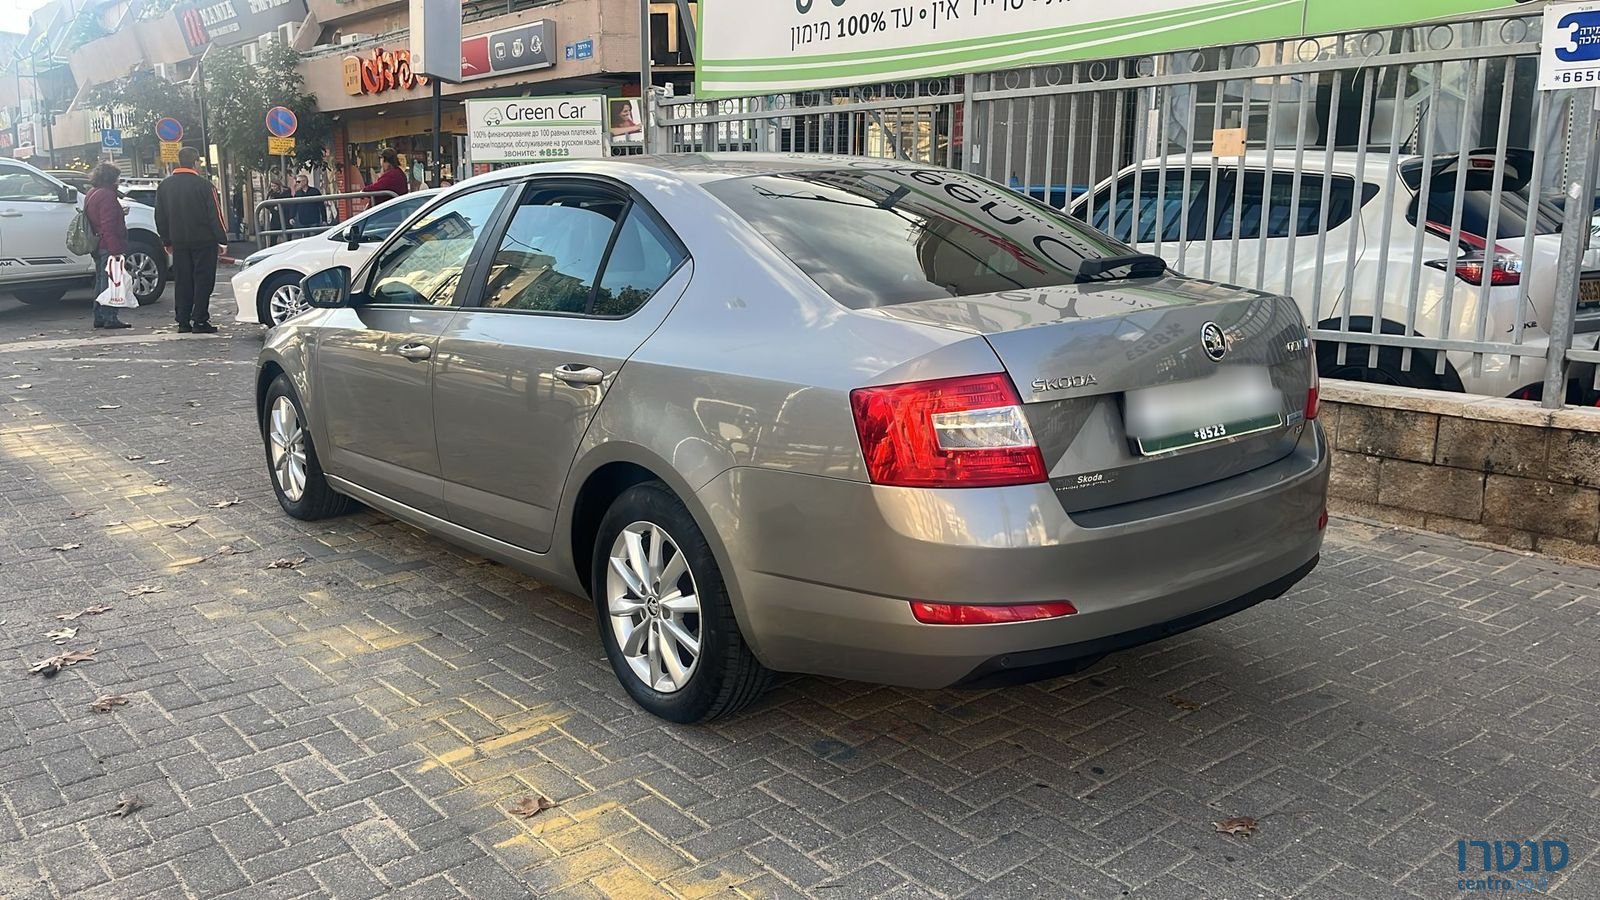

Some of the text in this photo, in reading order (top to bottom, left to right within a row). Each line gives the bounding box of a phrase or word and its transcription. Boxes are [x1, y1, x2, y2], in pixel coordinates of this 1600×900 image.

[837, 10, 887, 38] 100%
[890, 6, 914, 29] עד
[791, 21, 831, 51] מימון
[505, 101, 587, 121] Green Car
[540, 129, 550, 137] 100
[504, 149, 537, 157] звоните:
[1077, 473, 1103, 484] Skoda
